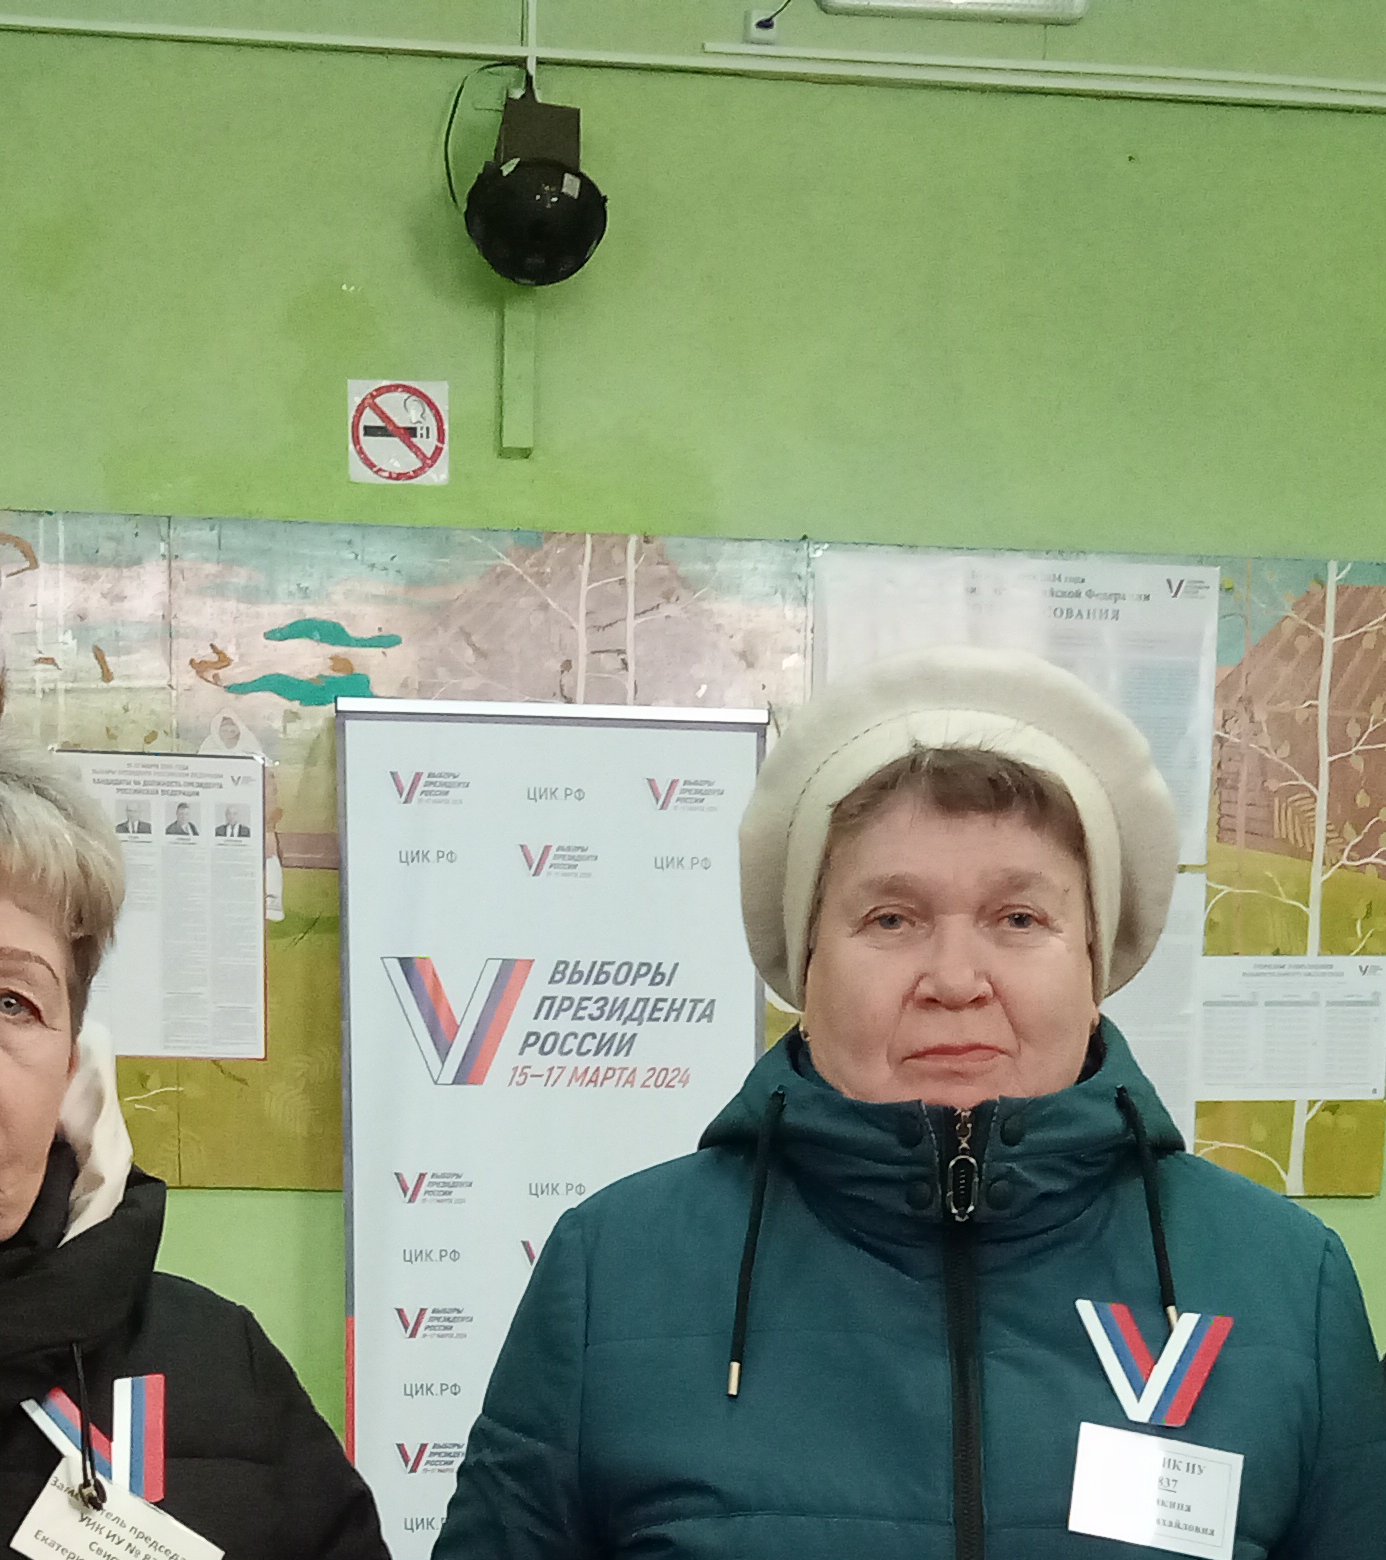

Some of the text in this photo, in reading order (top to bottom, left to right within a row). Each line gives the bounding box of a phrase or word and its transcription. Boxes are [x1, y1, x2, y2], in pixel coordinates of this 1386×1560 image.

[547, 959, 680, 987] ВЫБОРЫ
[533, 995, 717, 1026] ПРЕЗИДЕНТА
[518, 1031, 638, 1058] РОССИИ
[567, 1066, 637, 1088] МАРТА
[639, 1067, 692, 1089] 2024
[402, 1248, 461, 1264] ЦИК.РФ
[403, 1383, 461, 1398] ЦИК.РФ
[49, 1475, 127, 1529] Замтель
[77, 1511, 106, 1537] УИК
[403, 1517, 448, 1533] ЦИК.
